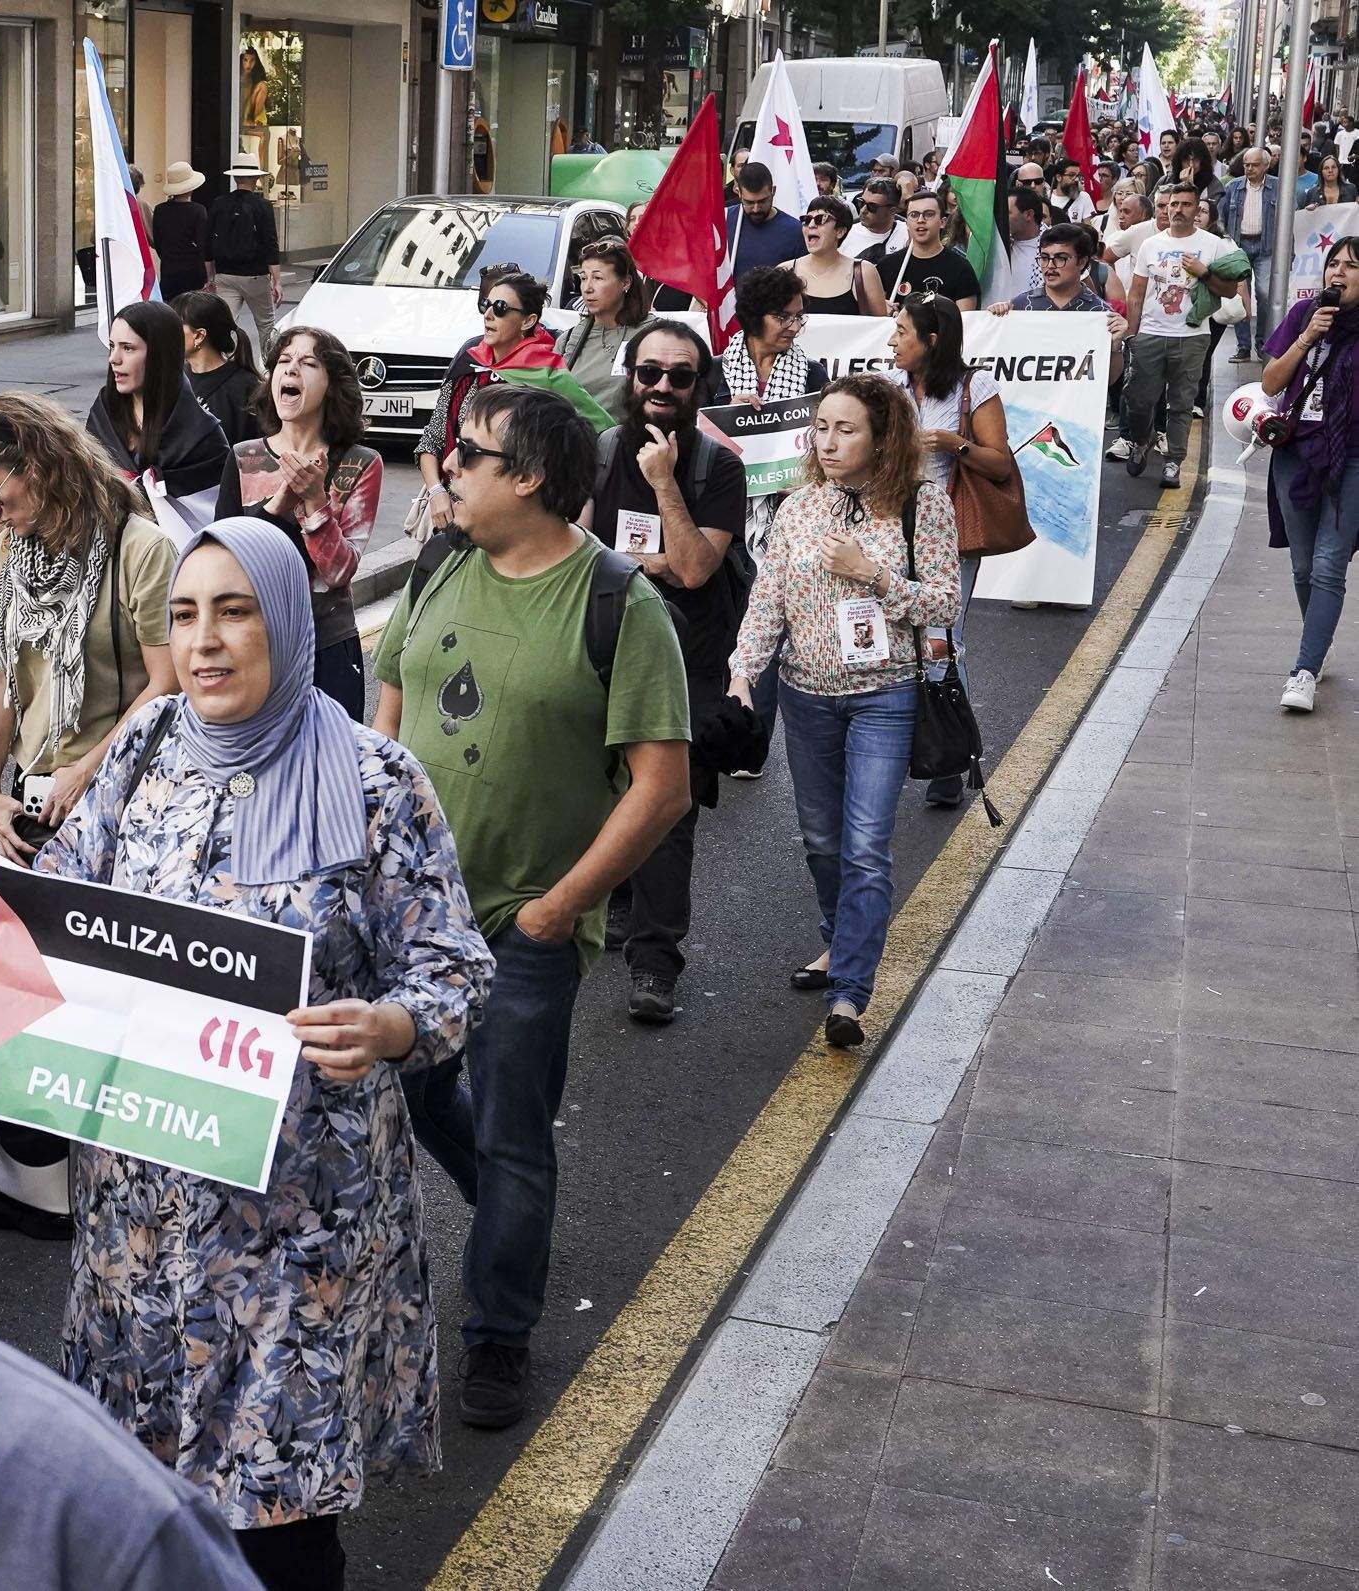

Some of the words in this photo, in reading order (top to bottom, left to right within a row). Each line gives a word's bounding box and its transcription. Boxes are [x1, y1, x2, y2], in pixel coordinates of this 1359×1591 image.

[264, 36, 303, 50] LOLA
[970, 350, 1095, 382] ENCERÁ
[379, 399, 409, 414] JNH
[735, 412, 782, 428] GALIZA
[782, 406, 811, 421] CON
[64, 910, 179, 962] GALIZA
[186, 940, 258, 982] CON
[198, 1016, 275, 1080] CIG
[26, 1065, 221, 1148] PALESTINA
